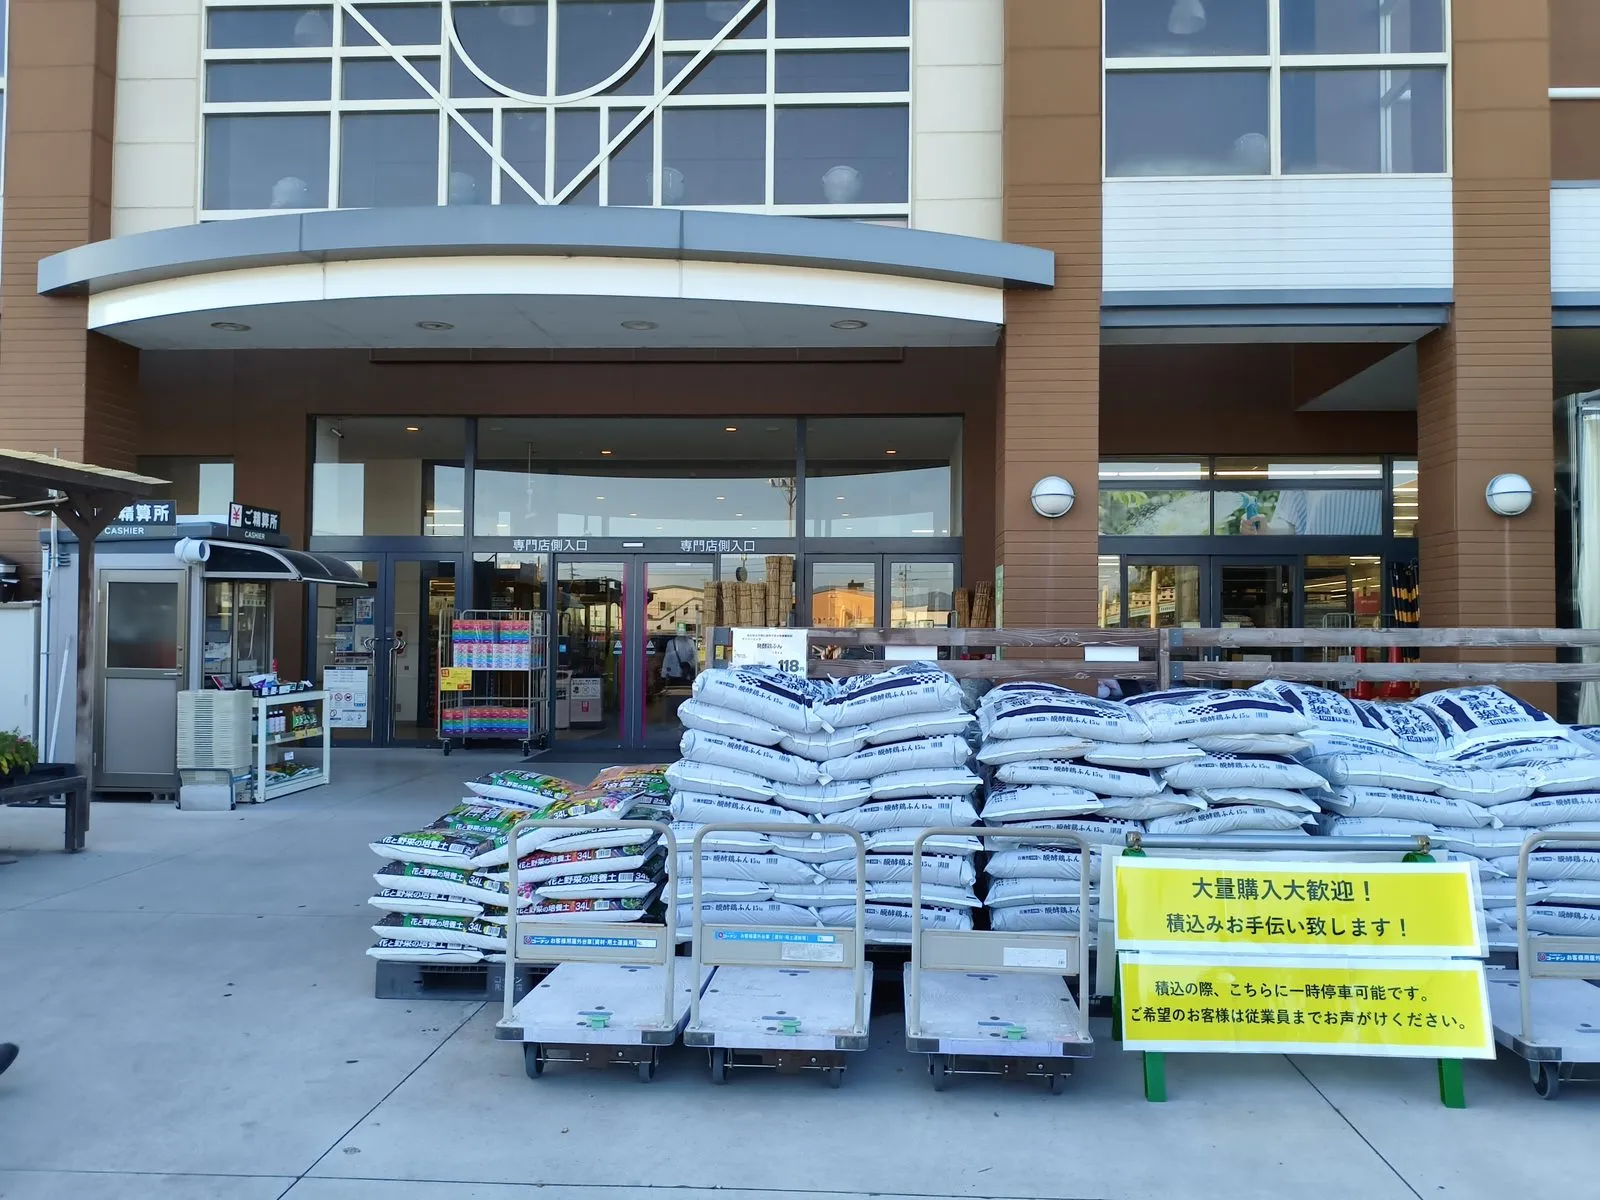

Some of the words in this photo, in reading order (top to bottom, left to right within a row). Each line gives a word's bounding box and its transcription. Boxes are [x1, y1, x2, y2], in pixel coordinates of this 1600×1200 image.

[244, 509, 279, 531] ご精算所
[104, 526, 145, 535] CASHIER
[244, 531, 266, 541] CASHIER
[513, 539, 588, 551] 専門店側入口
[680, 540, 755, 552] 専門店側入口
[382, 837, 449, 851] 花と野菜の培養土
[518, 855, 572, 869] 花と野菜の培養土
[577, 851, 592, 860] 34L
[411, 867, 465, 882] 花と野菜の培養土
[468, 875, 483, 887] 34L
[548, 874, 617, 886] 花と野菜の培養土
[1192, 877, 1372, 902] 大量購入大歓迎！
[575, 901, 590, 911] 34L
[410, 917, 464, 930] 花と野菜の培養土
[468, 922, 483, 933] 34L
[1166, 913, 1408, 937] 積込みお手伝い致します！
[1154, 980, 1429, 1003] 積込の際、こちらに一時停車可能です。
[1130, 1007, 1467, 1030] ご希望のお客様は従業員までお声がけください。
